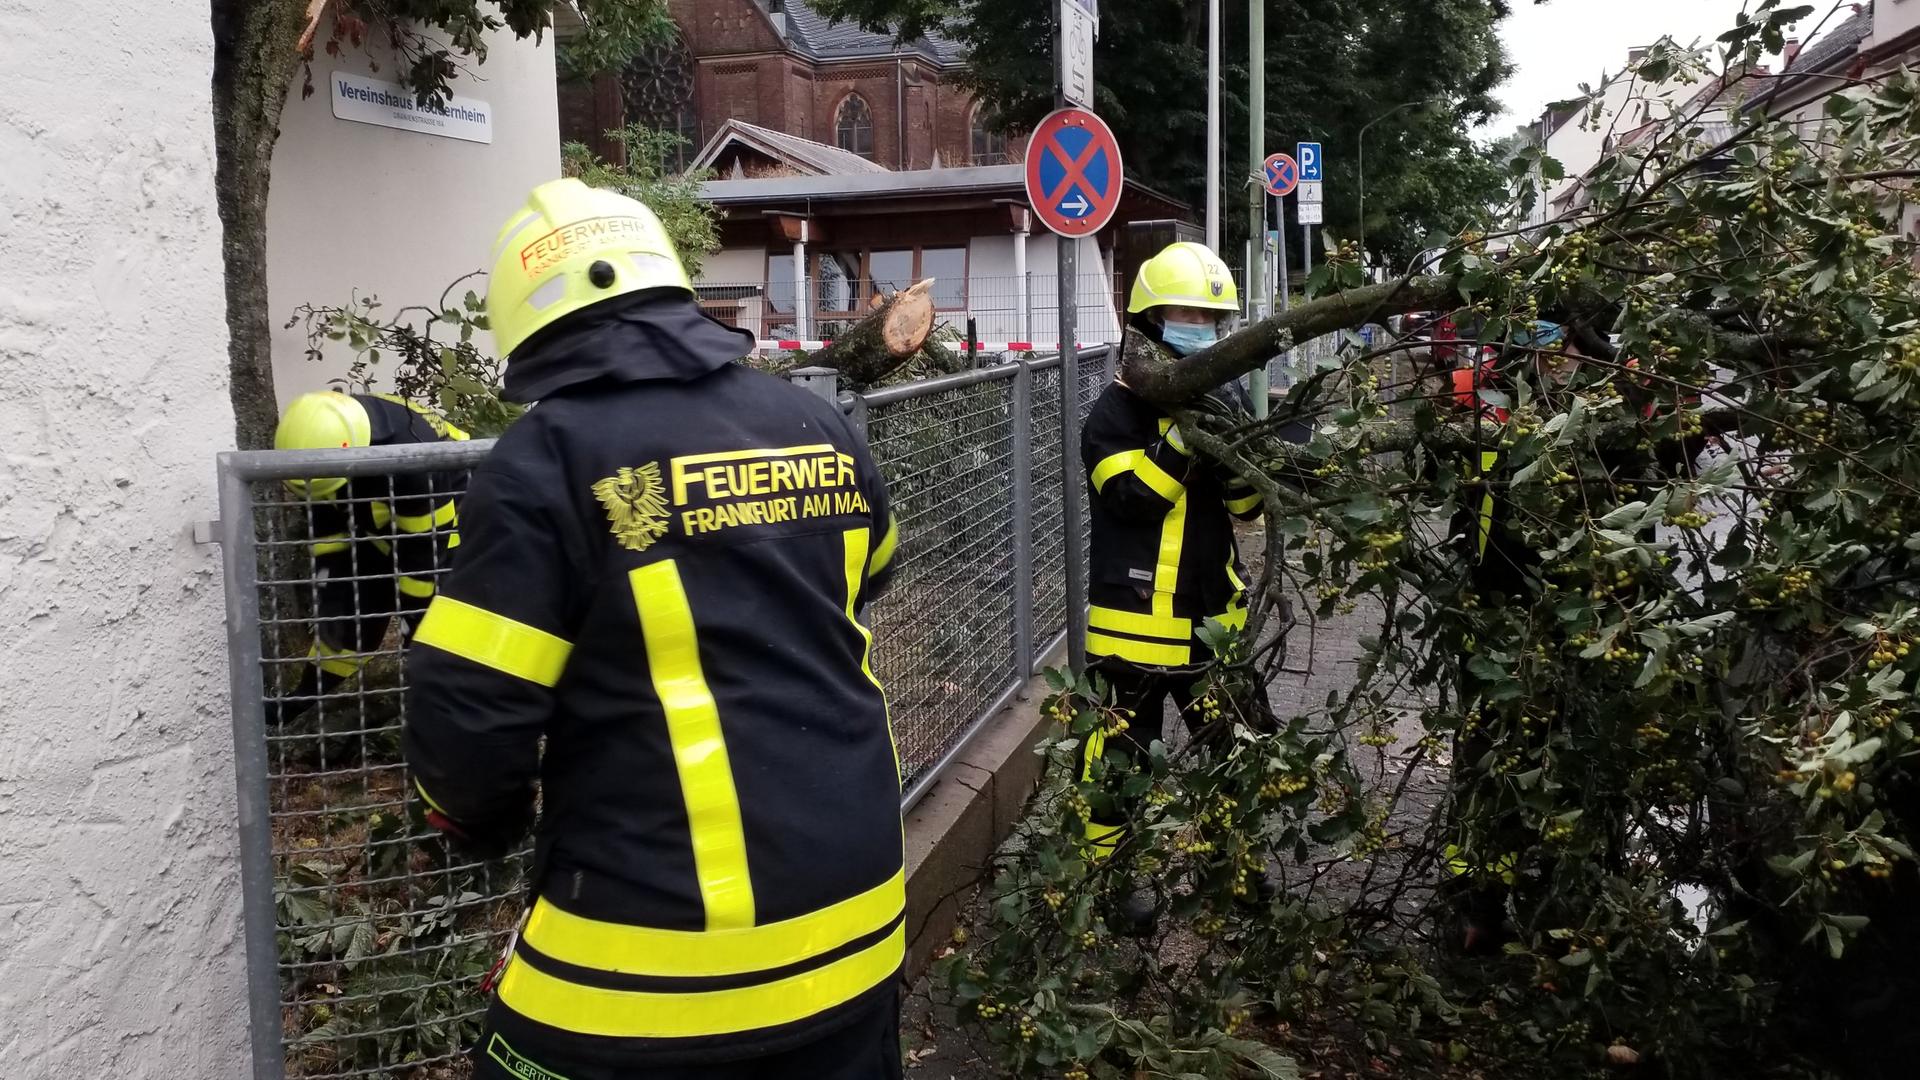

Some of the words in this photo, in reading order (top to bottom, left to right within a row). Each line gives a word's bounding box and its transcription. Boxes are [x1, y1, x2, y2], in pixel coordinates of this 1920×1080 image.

[338, 80, 413, 111] Vereinshaus
[416, 97, 486, 125] eernheim
[1302, 147, 1315, 176] P
[521, 216, 645, 270] FEUERWEHR
[1207, 263, 1220, 275] 22
[681, 497, 797, 536] FRANKFURT
[802, 493, 831, 519] AM
[834, 491, 870, 514] MAI
